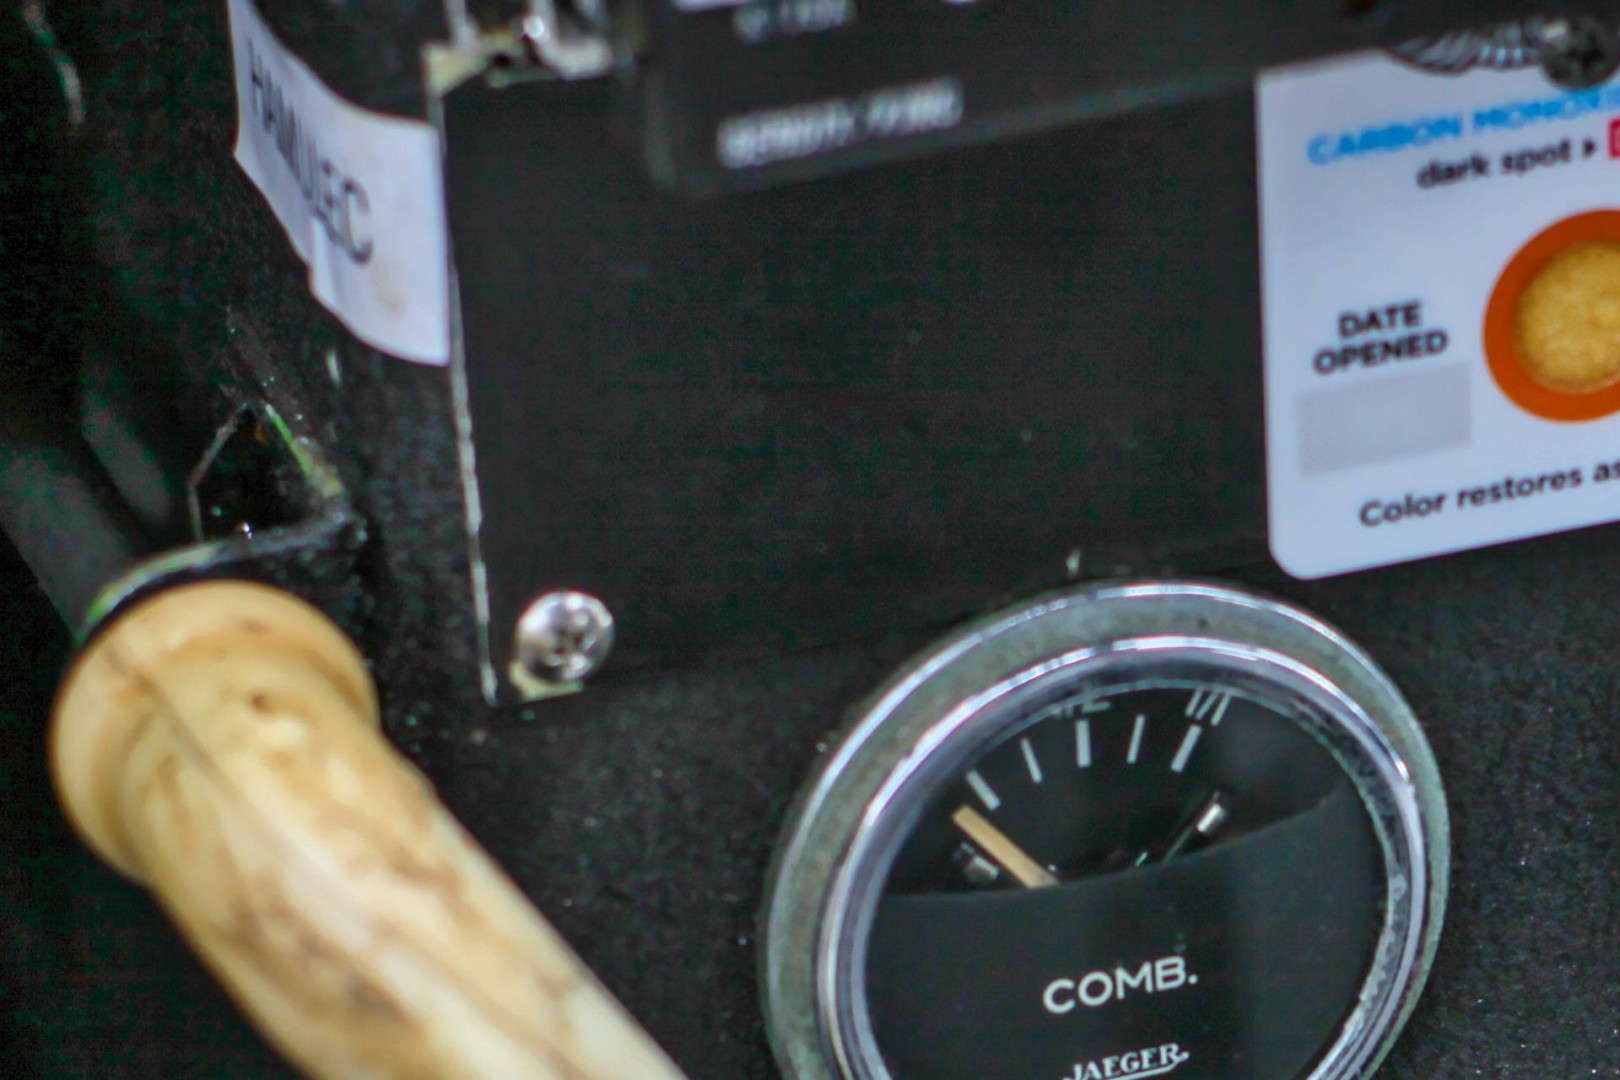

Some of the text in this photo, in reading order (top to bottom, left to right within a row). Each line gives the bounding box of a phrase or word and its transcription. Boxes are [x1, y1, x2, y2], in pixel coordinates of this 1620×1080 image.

[1307, 116, 1462, 166] CARBON
[1415, 157, 1489, 188] dark
[1501, 137, 1571, 174] spot
[1338, 298, 1422, 339] DATE
[1313, 328, 1449, 376] OPENED
[1358, 491, 1447, 528] Color
[1456, 468, 1583, 509] restores
[1042, 955, 1198, 1015] COMB.
